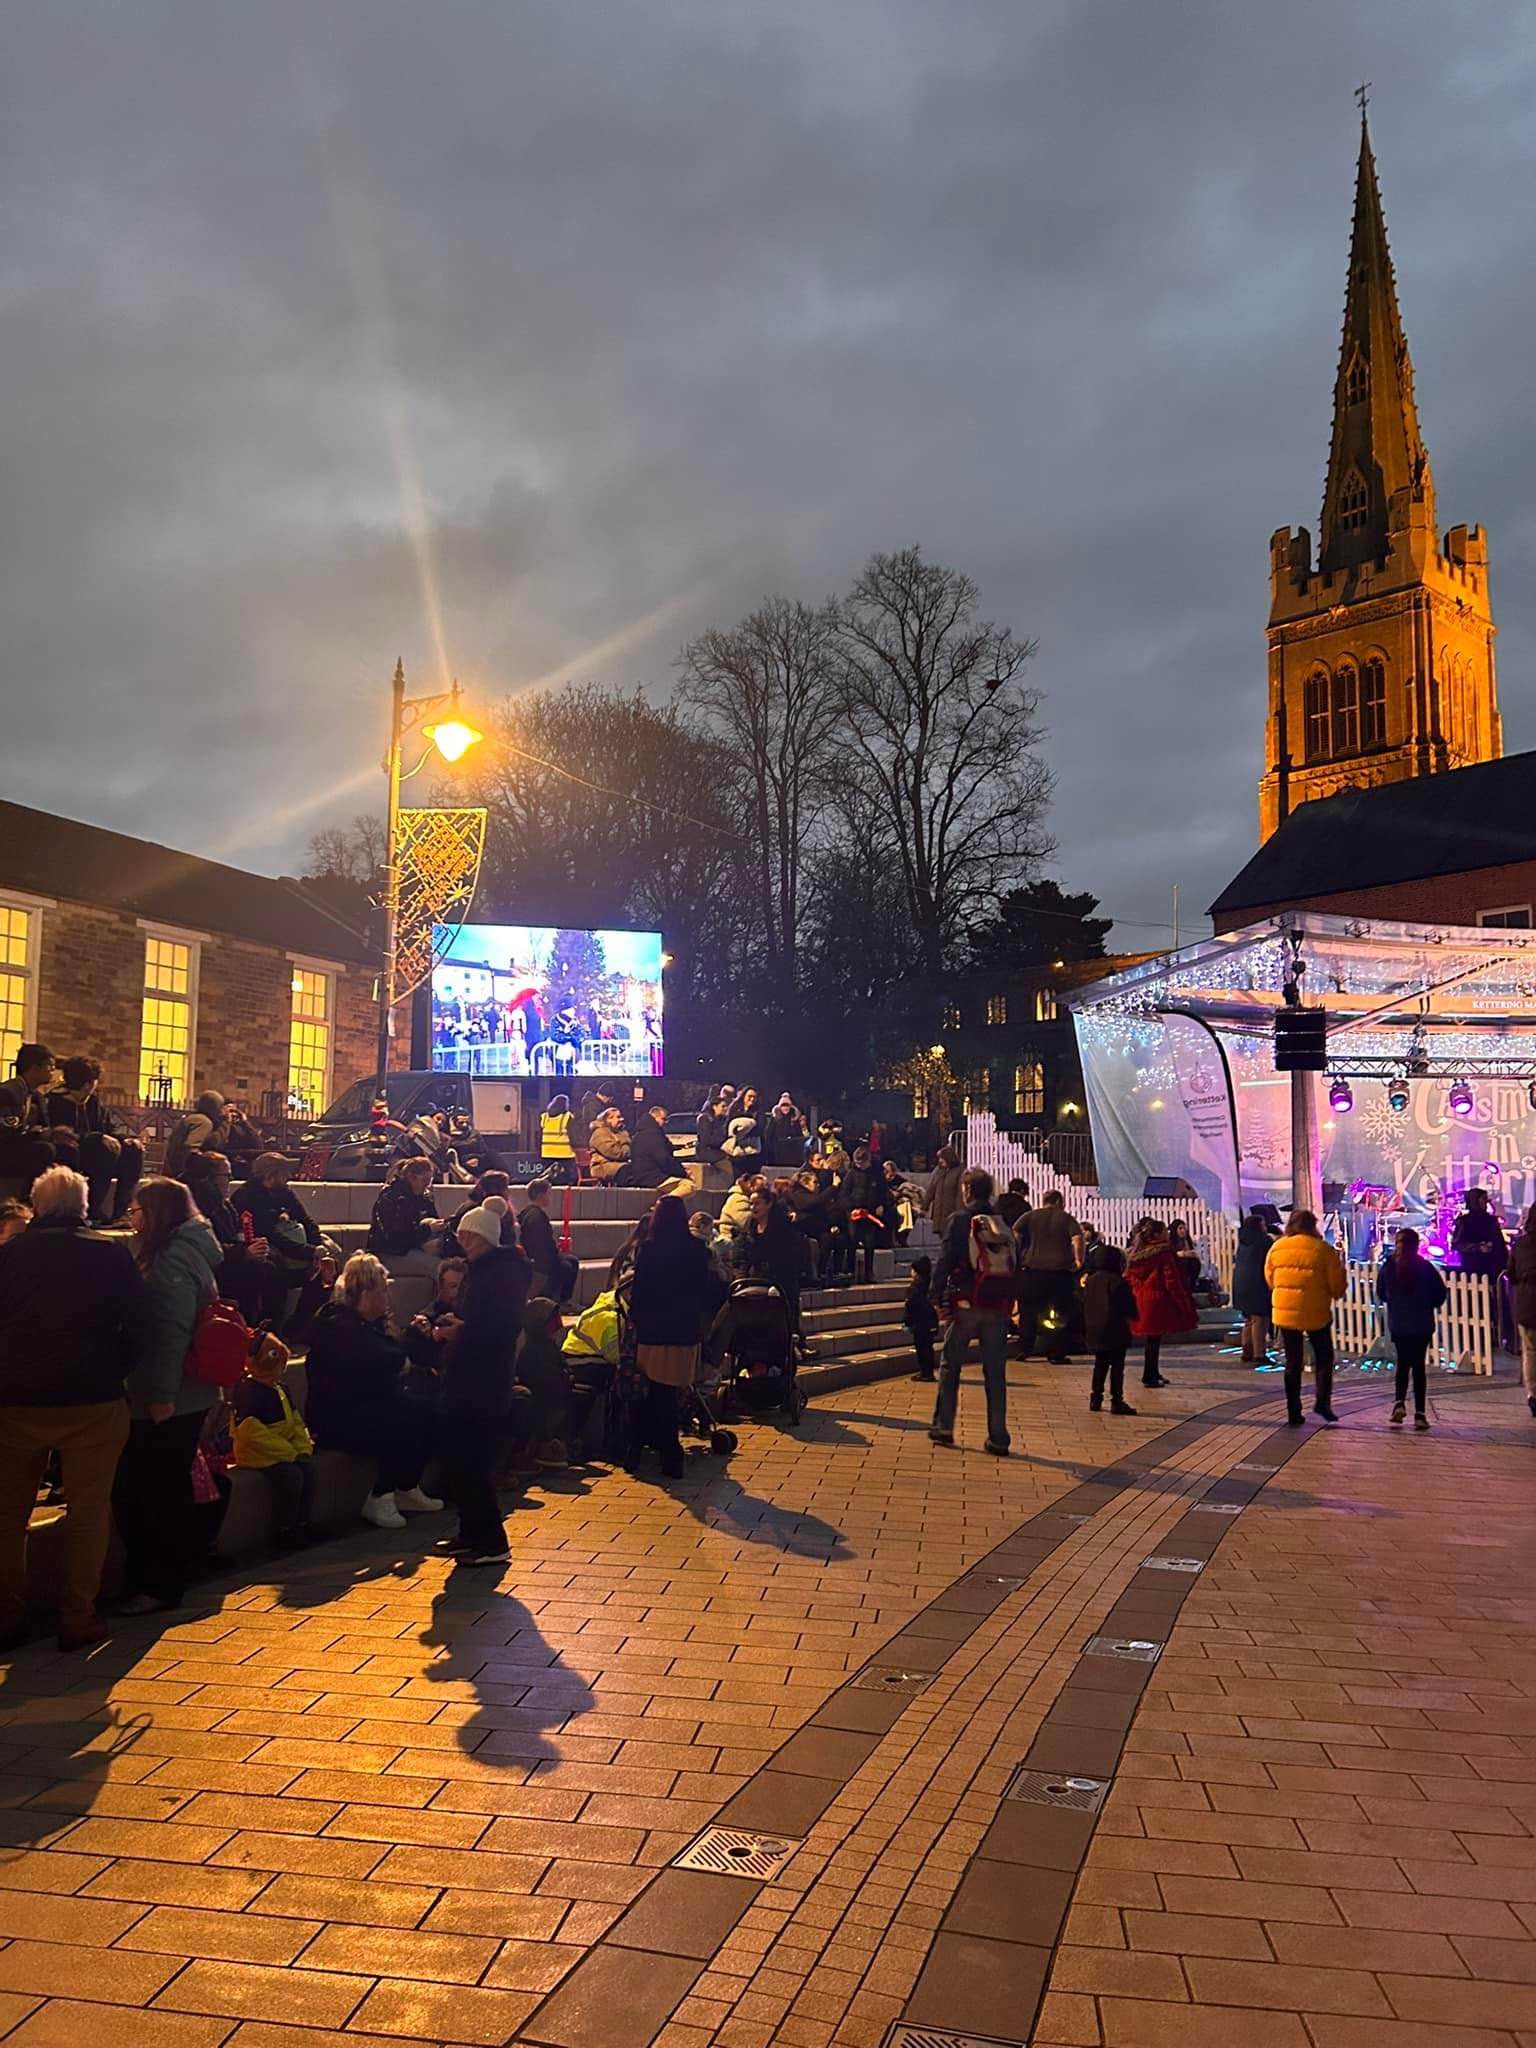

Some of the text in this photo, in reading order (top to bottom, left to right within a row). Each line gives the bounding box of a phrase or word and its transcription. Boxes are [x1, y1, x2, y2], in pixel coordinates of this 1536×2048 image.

[1472, 1000, 1523, 1009] KETTERING
[1488, 1129, 1521, 1164] in
[1393, 1150, 1536, 1209] Ketteri
